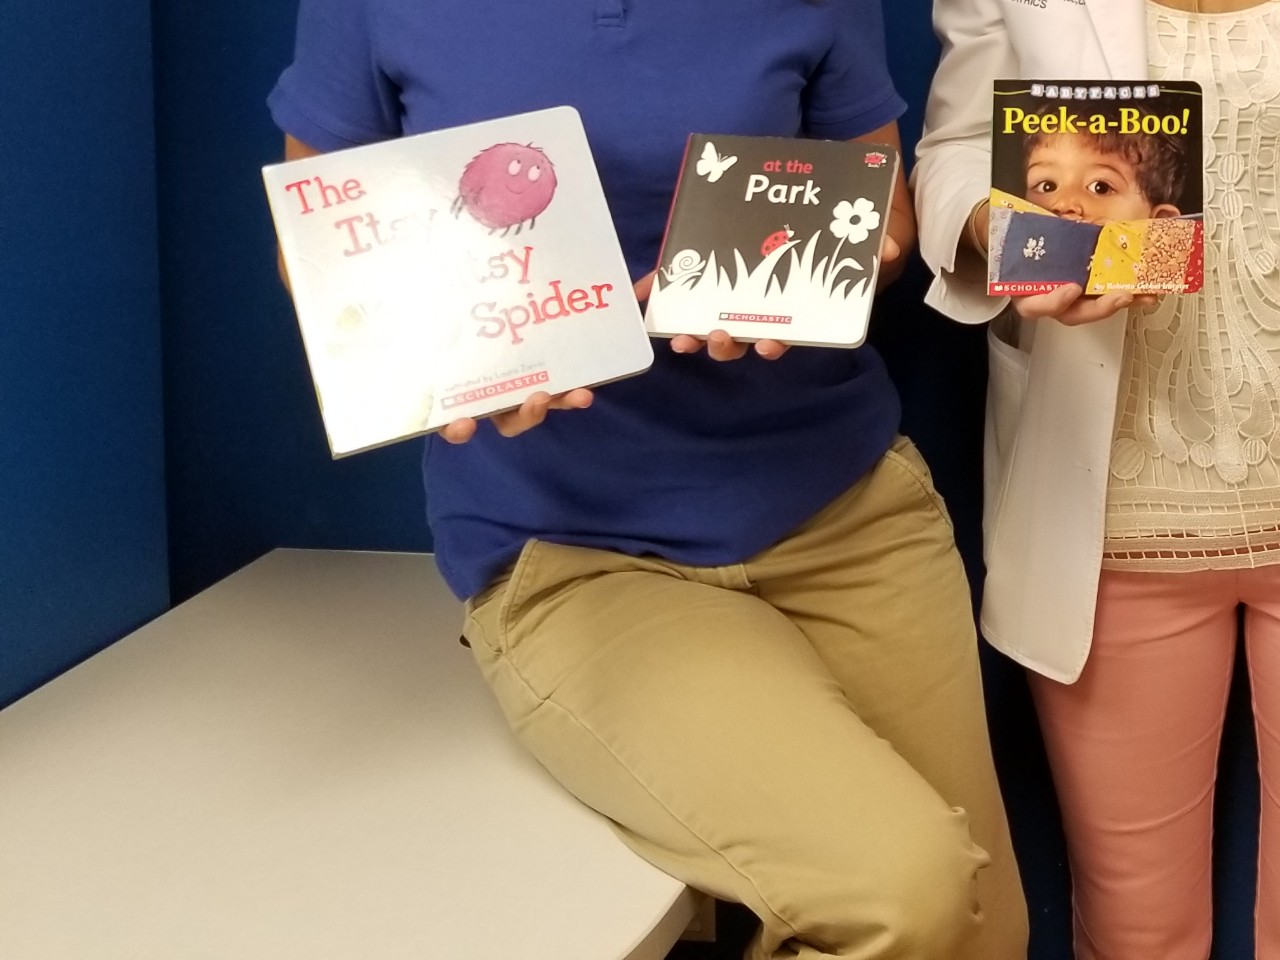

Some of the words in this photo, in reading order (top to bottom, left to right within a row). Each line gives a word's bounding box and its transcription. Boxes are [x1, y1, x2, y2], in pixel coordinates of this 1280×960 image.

[1002, 106, 1190, 135] Peek-a-Boo!
[763, 160, 782, 173] at
[785, 159, 813, 174] the
[284, 176, 367, 215] The
[744, 174, 822, 206] Park
[470, 279, 614, 345] Spider
[728, 313, 792, 324] SCHOLASTIC
[454, 371, 548, 404] SCHOLASTIC
